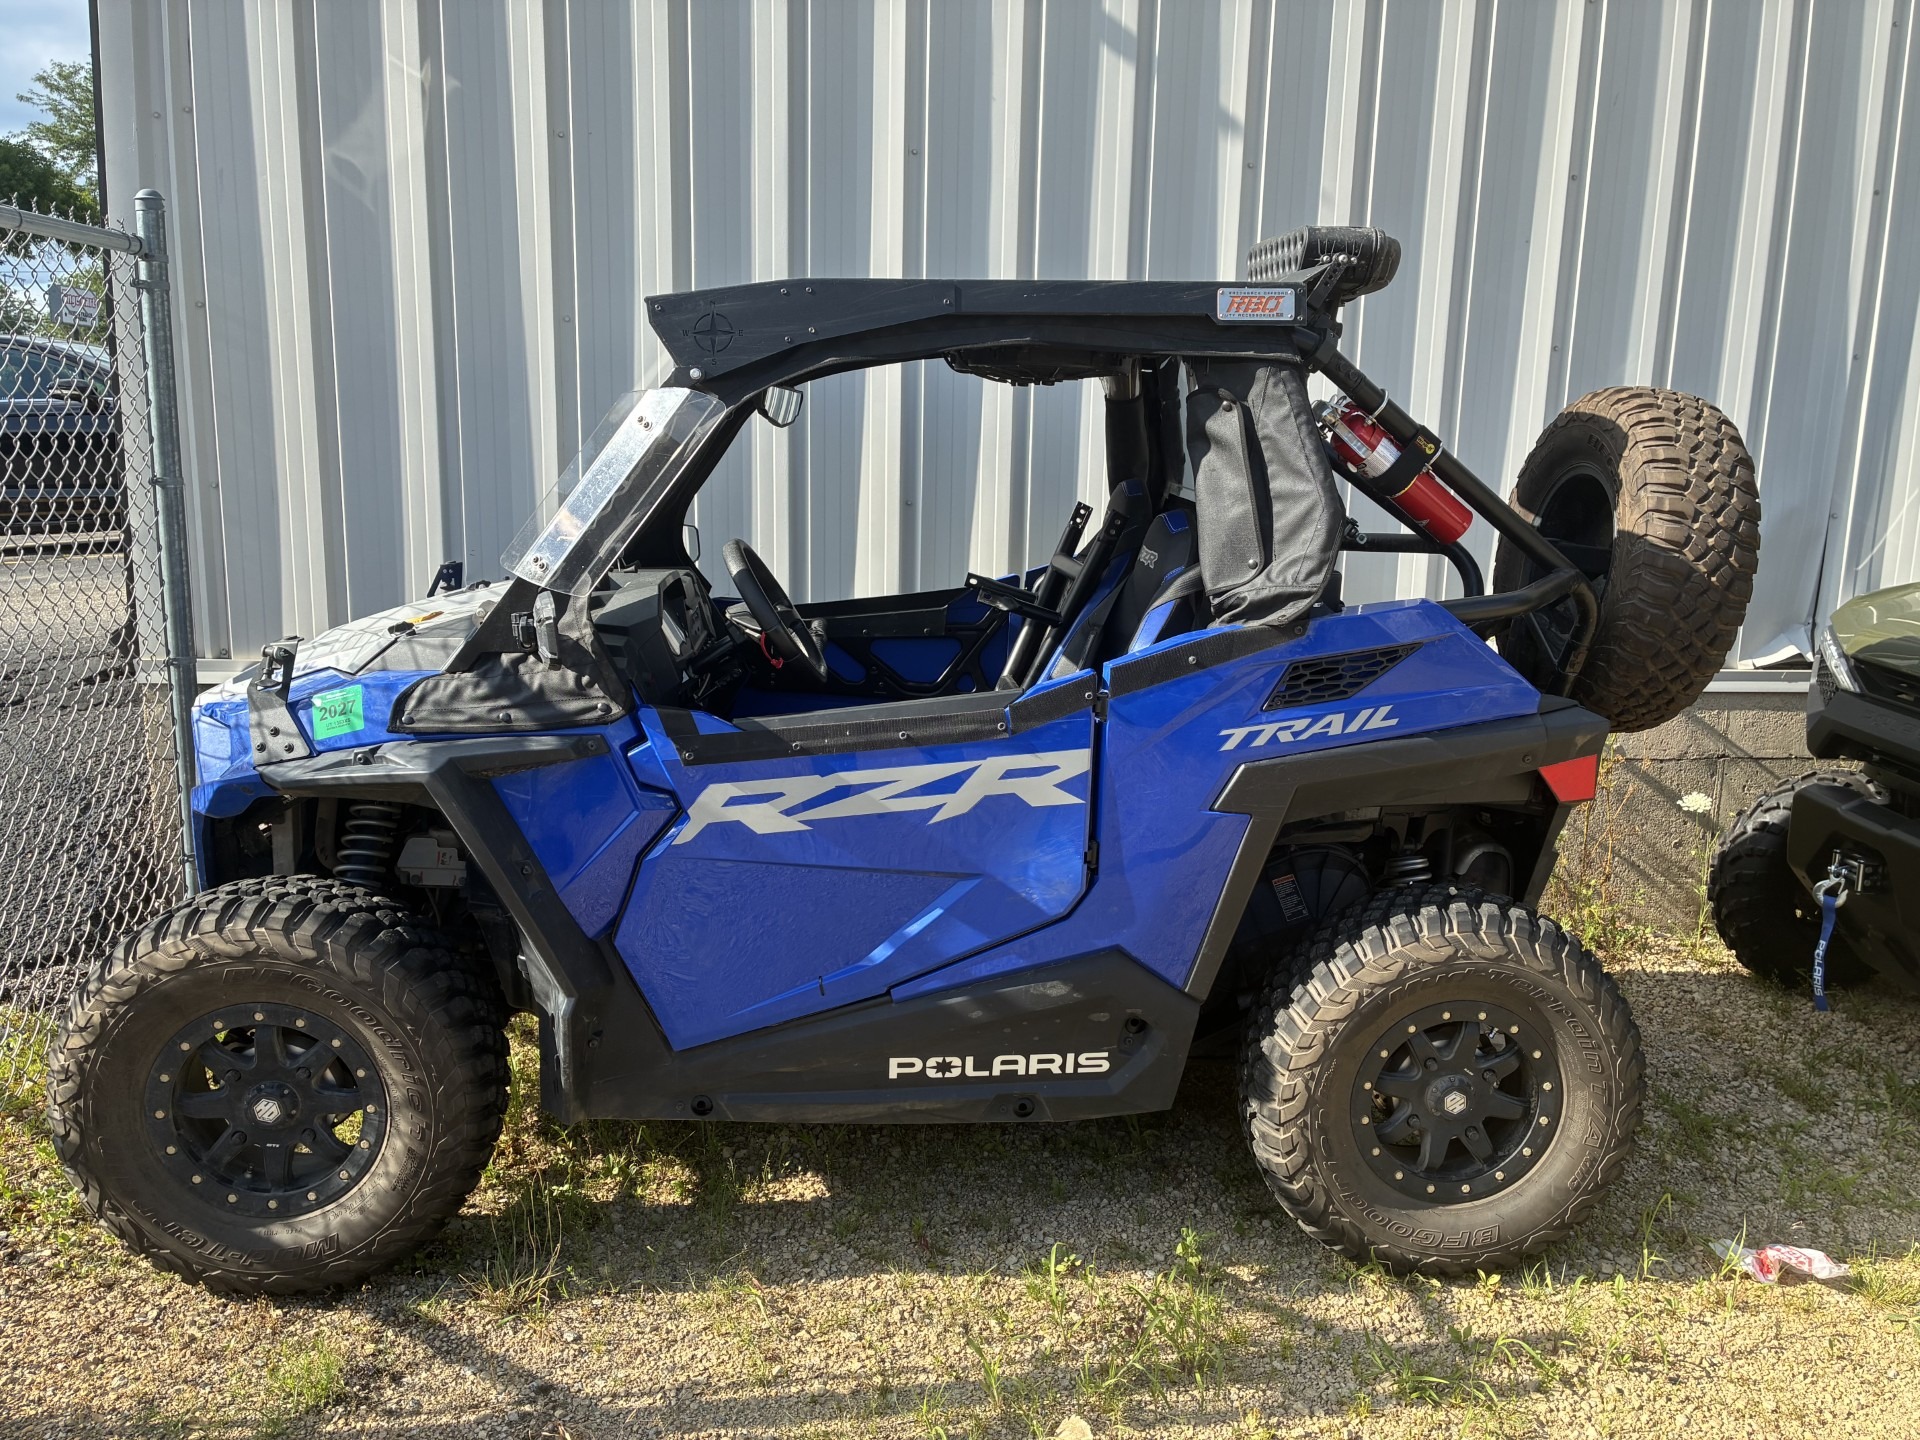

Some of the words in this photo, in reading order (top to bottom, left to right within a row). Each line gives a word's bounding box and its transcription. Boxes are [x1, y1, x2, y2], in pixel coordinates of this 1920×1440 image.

[709, 300, 716, 308] N
[682, 329, 690, 337] W
[738, 329, 744, 337] E
[319, 699, 356, 721] 2027
[1218, 705, 1400, 752] TRAIL
[672, 748, 1091, 845] RZR
[1813, 939, 1826, 997] POLARIS
[888, 1051, 1111, 1080] POLARIS
